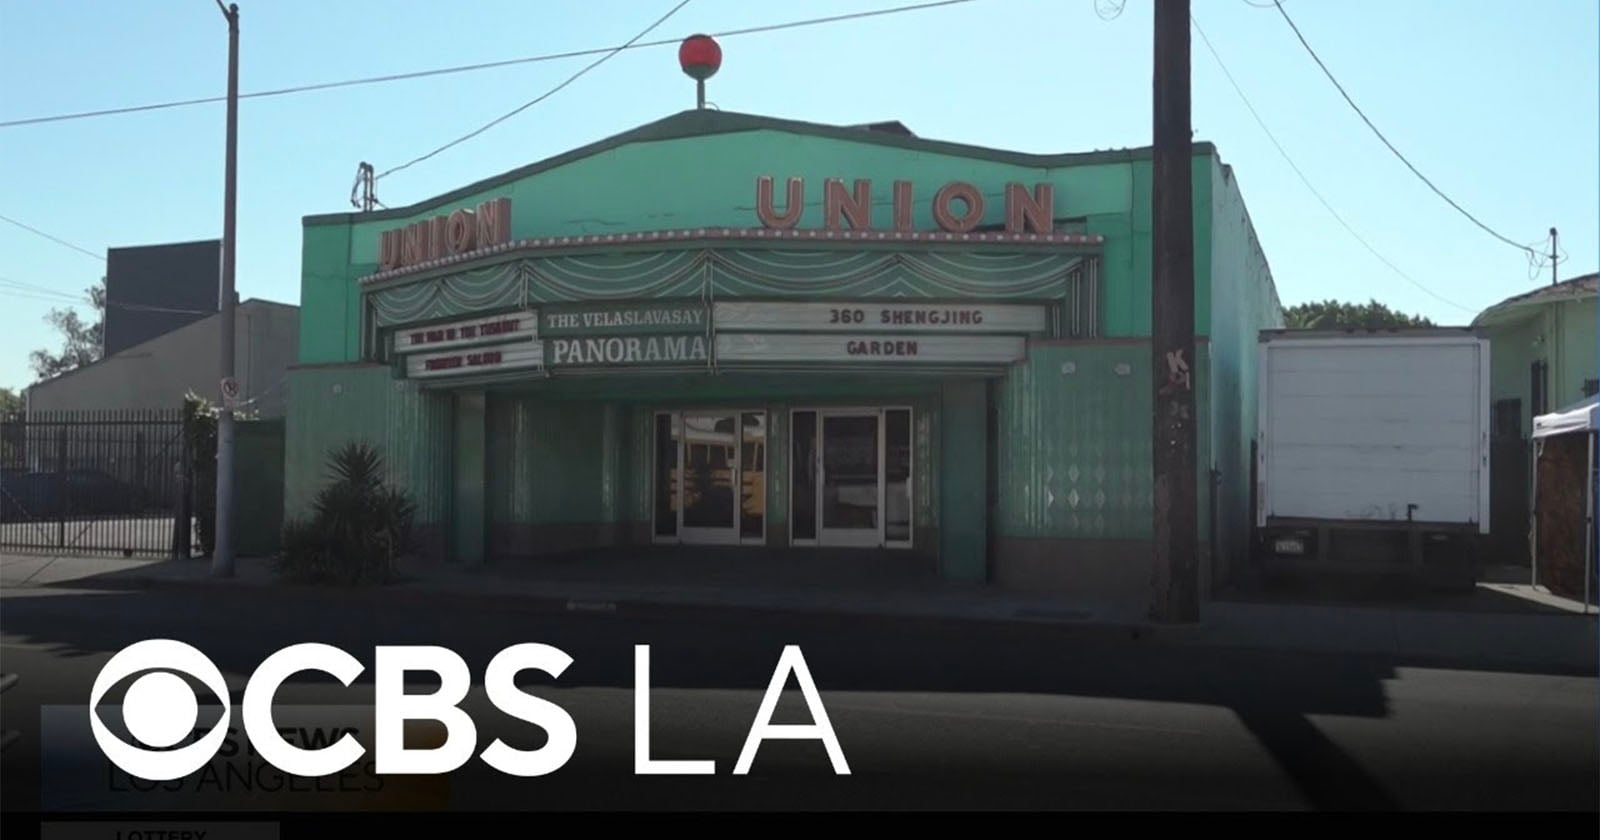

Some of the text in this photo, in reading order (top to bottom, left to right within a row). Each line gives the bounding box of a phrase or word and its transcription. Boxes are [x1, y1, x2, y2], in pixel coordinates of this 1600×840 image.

[756, 175, 1055, 234] UNION
[380, 198, 510, 270] UNION
[547, 309, 704, 330] THE VELASLAVASAY
[829, 308, 984, 325] 360 SHENGJING
[552, 335, 708, 364] PANORAMA
[847, 340, 918, 356] GARDEN
